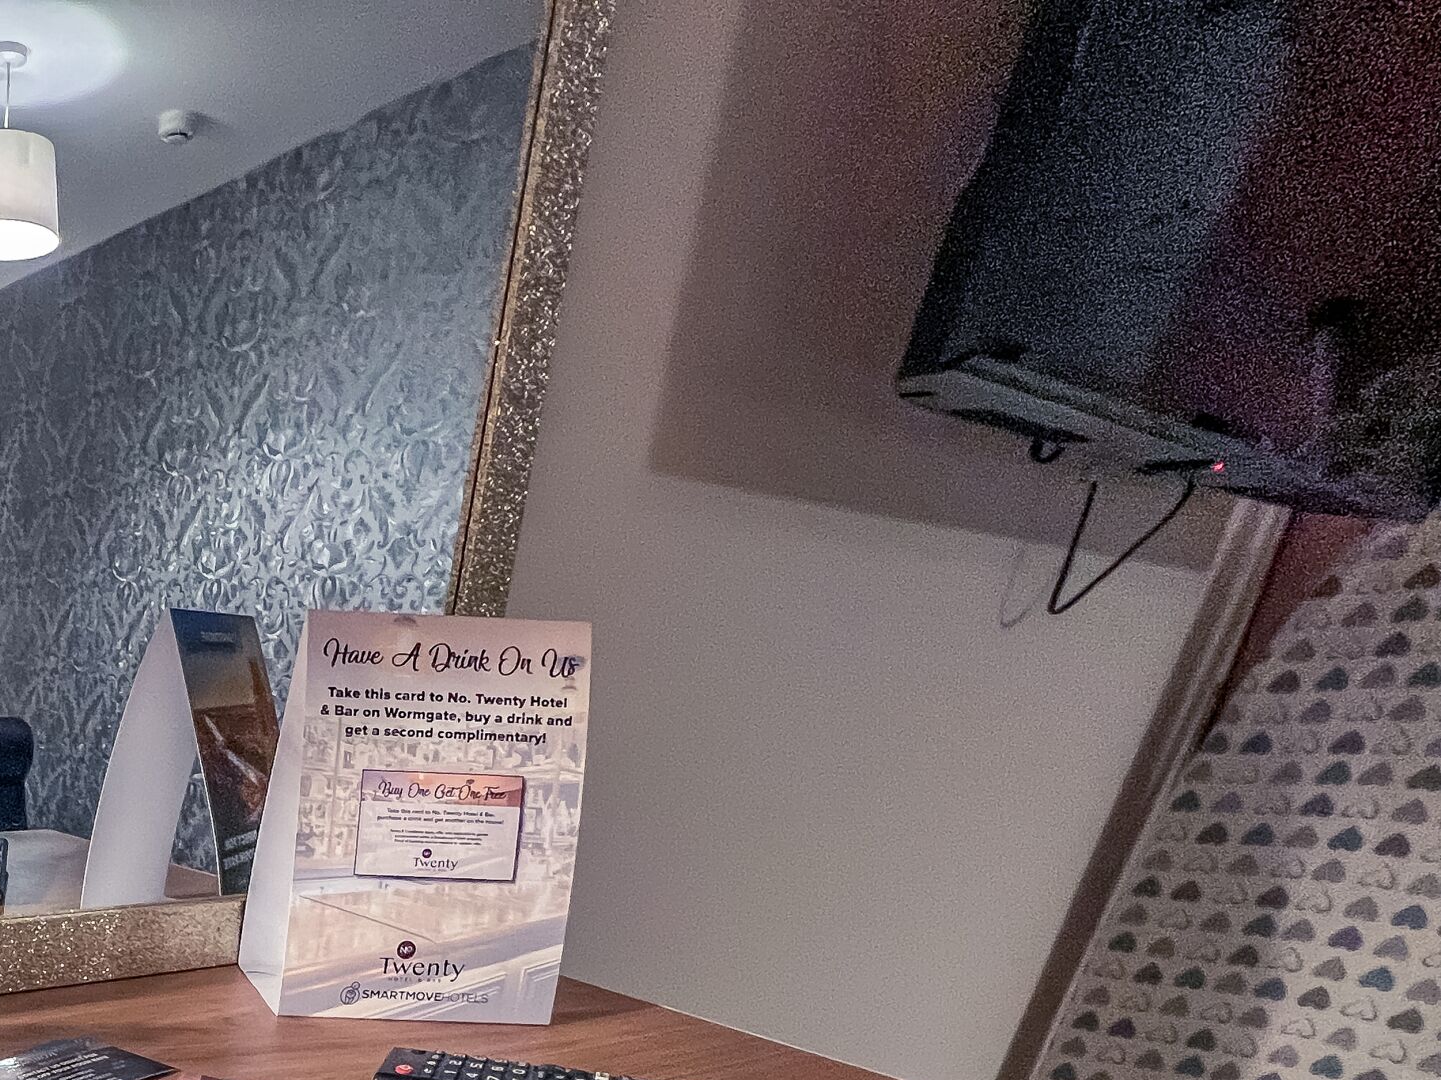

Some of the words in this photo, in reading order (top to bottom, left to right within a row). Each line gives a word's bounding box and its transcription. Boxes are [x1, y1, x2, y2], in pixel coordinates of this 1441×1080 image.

[323, 638, 384, 667] Have
[392, 642, 422, 672] A
[429, 643, 491, 672] Drink
[498, 646, 533, 676] On
[542, 648, 579, 678] Us
[328, 687, 360, 699] Take
[364, 688, 391, 700] this
[395, 690, 425, 702] card
[429, 692, 443, 702] to
[448, 692, 471, 704] No.
[475, 694, 526, 708] Twenty
[530, 696, 567, 708] Hotel
[320, 704, 330, 716] &
[334, 705, 359, 717] Bar
[363, 708, 380, 718] on
[384, 707, 461, 723] Wormgate,
[465, 711, 491, 726] buy
[495, 714, 503, 723] a
[507, 713, 543, 725] drink
[547, 715, 572, 727] and
[345, 726, 368, 738] get
[372, 727, 380, 736] a
[384, 726, 433, 738] second
[437, 728, 547, 745] complimentary!
[378, 779, 403, 800] Buy
[408, 782, 431, 799] One
[434, 784, 457, 799] Get
[458, 785, 482, 800] One
[413, 857, 459, 871] Twenty
[379, 957, 466, 982] Twenty
